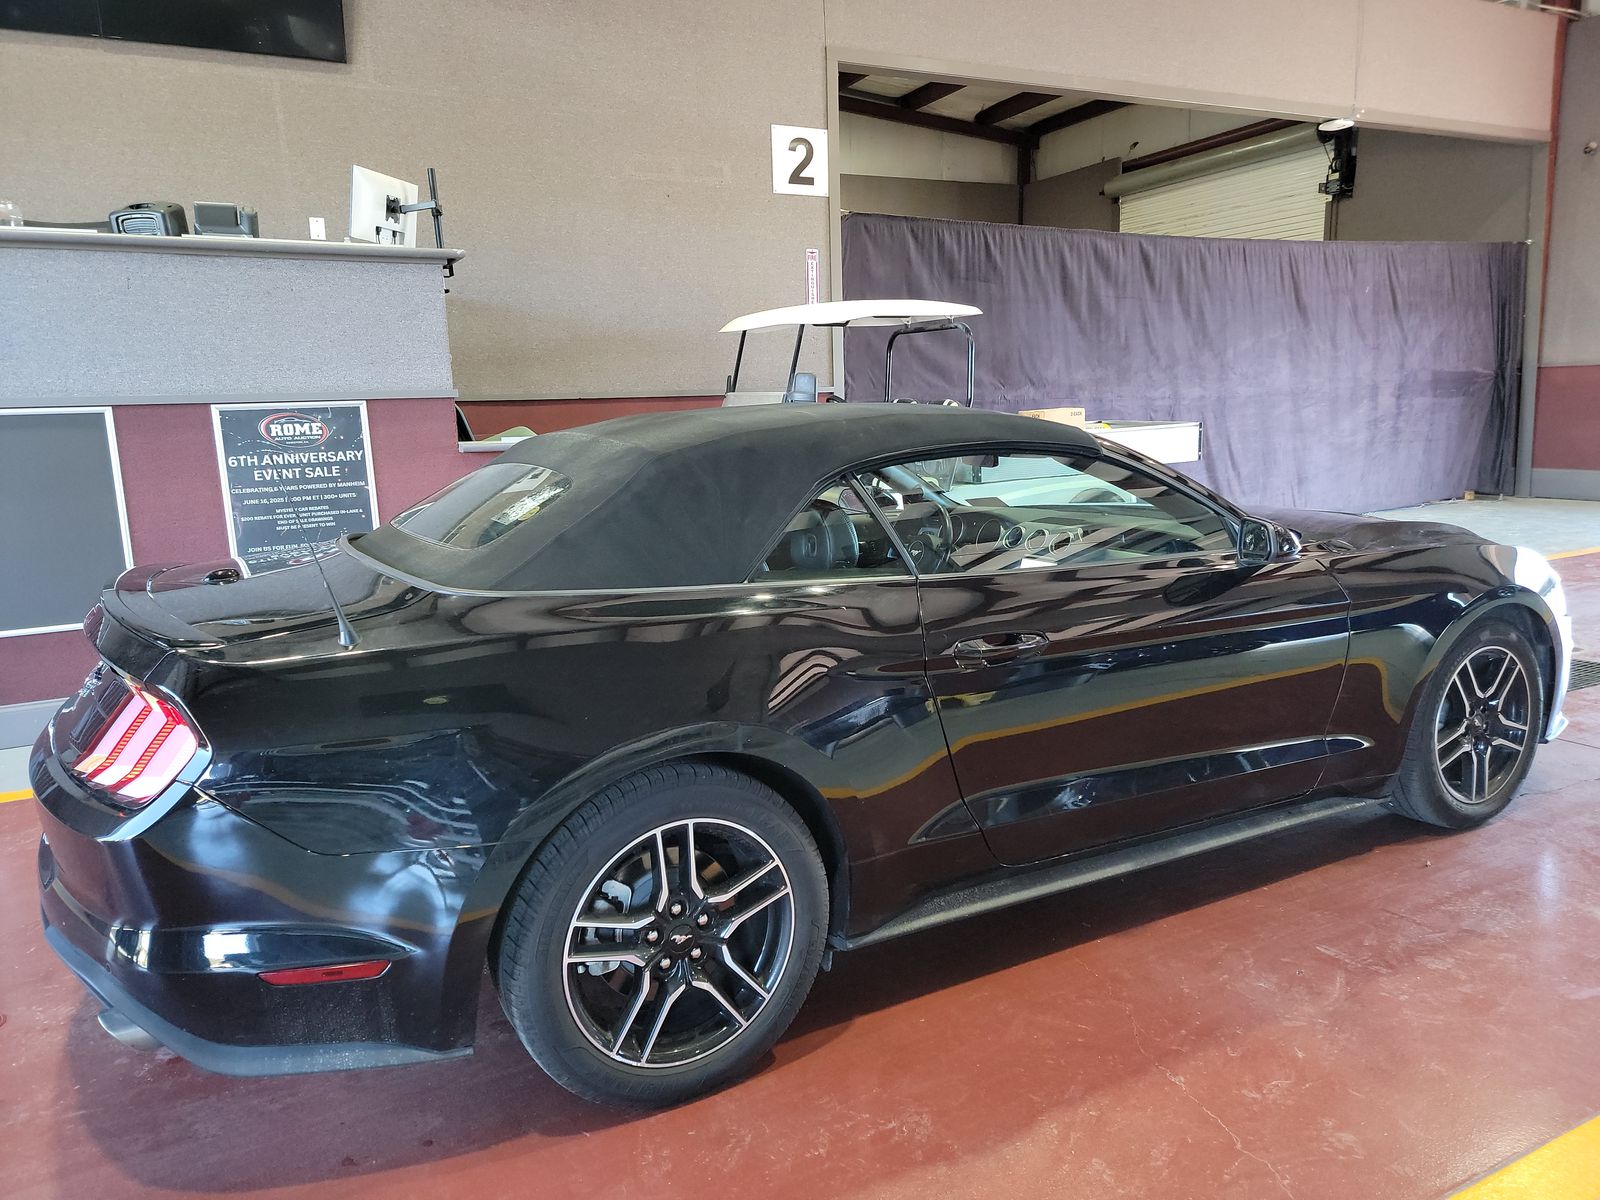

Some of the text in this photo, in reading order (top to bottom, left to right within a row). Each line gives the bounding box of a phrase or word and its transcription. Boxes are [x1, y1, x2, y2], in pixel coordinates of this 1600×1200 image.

[788, 137, 815, 186] 2
[269, 422, 323, 437] ROME
[228, 449, 364, 467] 6TH ANNIVERSARY
[254, 465, 341, 481] EVENT SALE
[231, 486, 273, 494] CELEBRATING
[336, 480, 366, 488] MANHEIM
